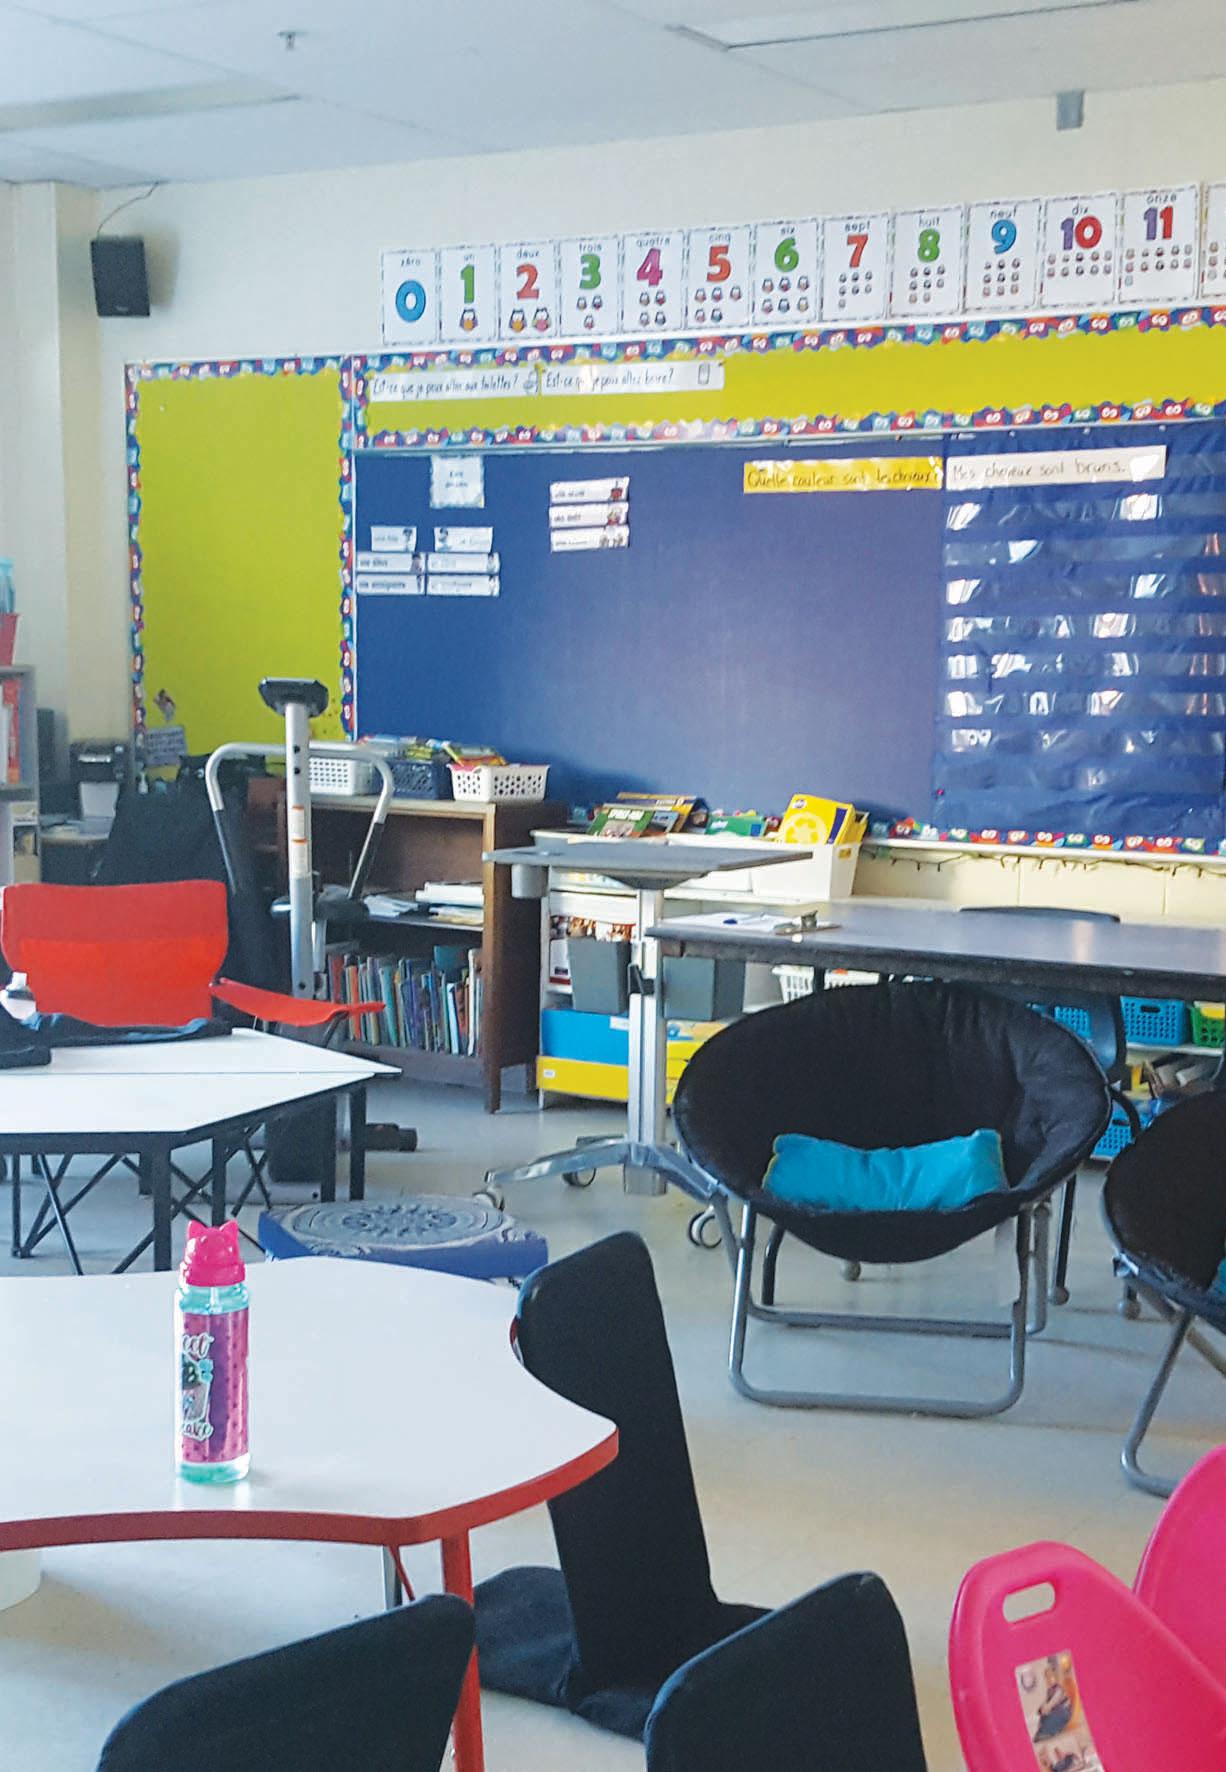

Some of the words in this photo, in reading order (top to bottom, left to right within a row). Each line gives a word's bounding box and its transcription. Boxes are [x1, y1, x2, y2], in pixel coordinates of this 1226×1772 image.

[991, 219, 1017, 255] 9
[1061, 216, 1103, 250] 10
[1144, 206, 1174, 240] 11
[774, 237, 800, 272] 6
[847, 234, 869, 268] 7
[917, 228, 940, 262] 8
[516, 263, 540, 300] 2
[579, 254, 602, 290] 3
[636, 248, 663, 286] 4
[706, 245, 731, 282] 5
[396, 280, 426, 323] 0
[461, 265, 475, 303] 1
